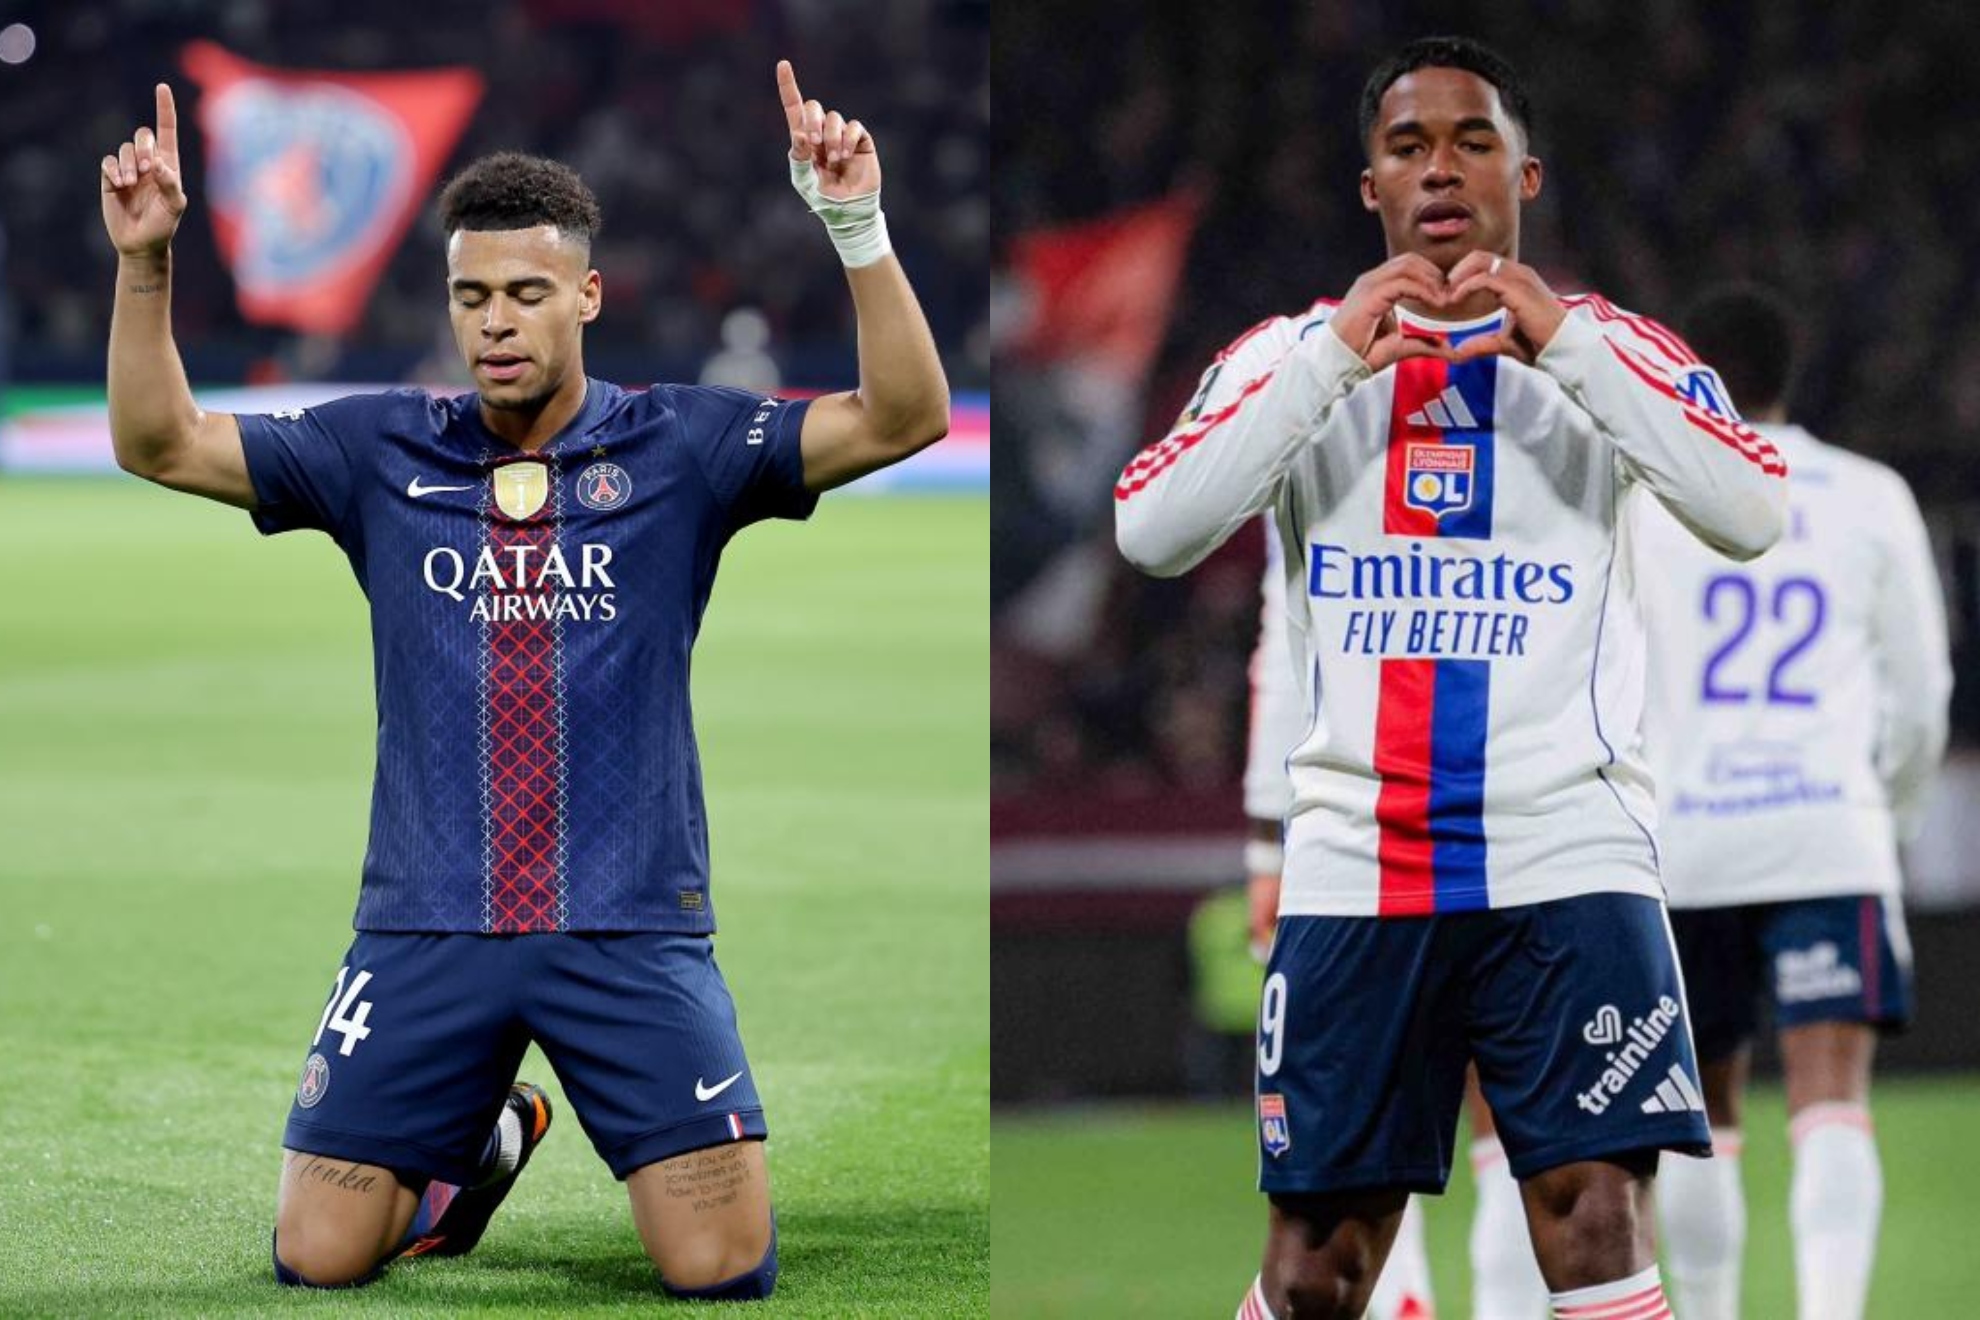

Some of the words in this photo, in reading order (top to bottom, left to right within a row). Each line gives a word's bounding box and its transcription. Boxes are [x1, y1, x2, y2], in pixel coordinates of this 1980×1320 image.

[584, 465, 620, 480] PARIS
[423, 543, 615, 601] QATAR
[1308, 542, 1574, 604] Emirates
[468, 593, 616, 623] AIRWAYS
[1343, 609, 1397, 653] FLY
[1407, 609, 1529, 656] BETTER
[1702, 574, 1826, 704] 22
[1260, 972, 1287, 1077] 9
[1577, 994, 1680, 1115] trainline
